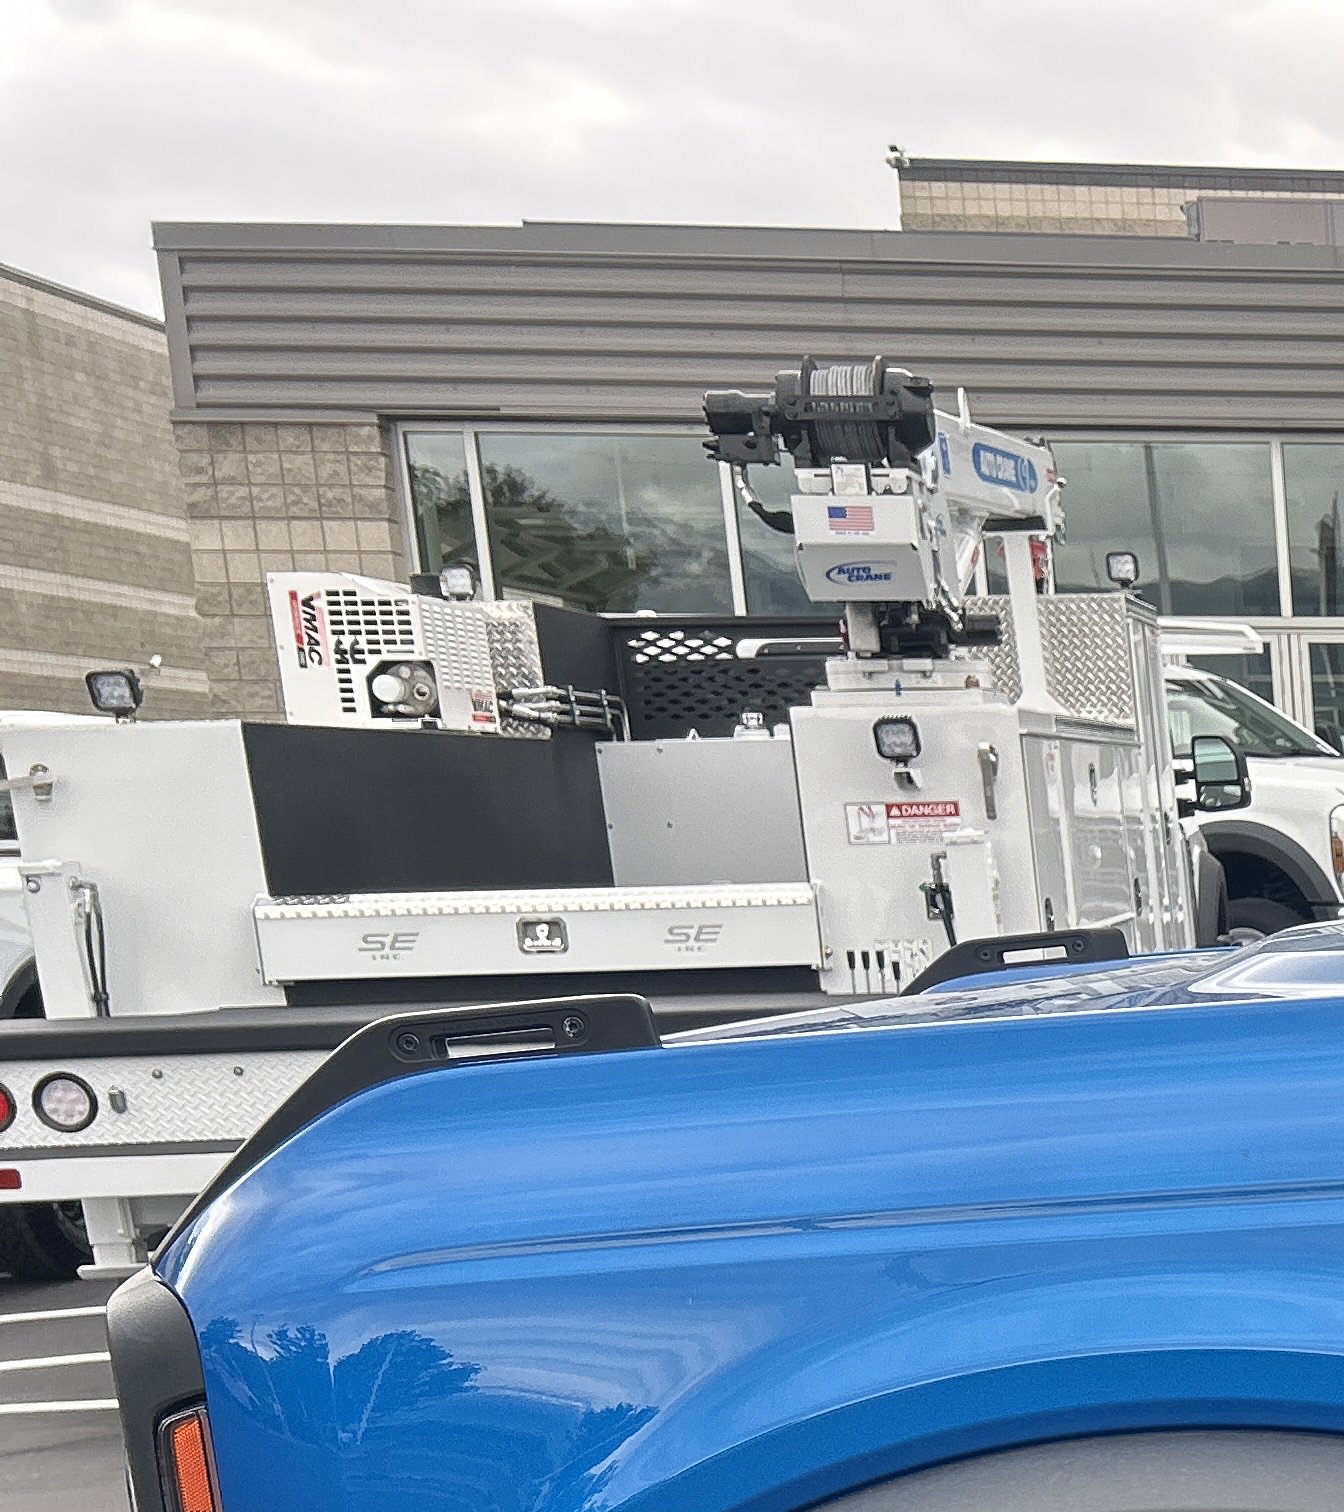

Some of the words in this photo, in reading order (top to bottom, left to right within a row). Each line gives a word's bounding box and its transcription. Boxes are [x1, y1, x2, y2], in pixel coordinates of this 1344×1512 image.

[837, 566, 871, 576] AUTO
[847, 572, 892, 582] CRANE
[301, 595, 323, 666] VMAC
[901, 804, 956, 816] DANGER
[664, 924, 724, 943] SE
[358, 932, 420, 952] SE
